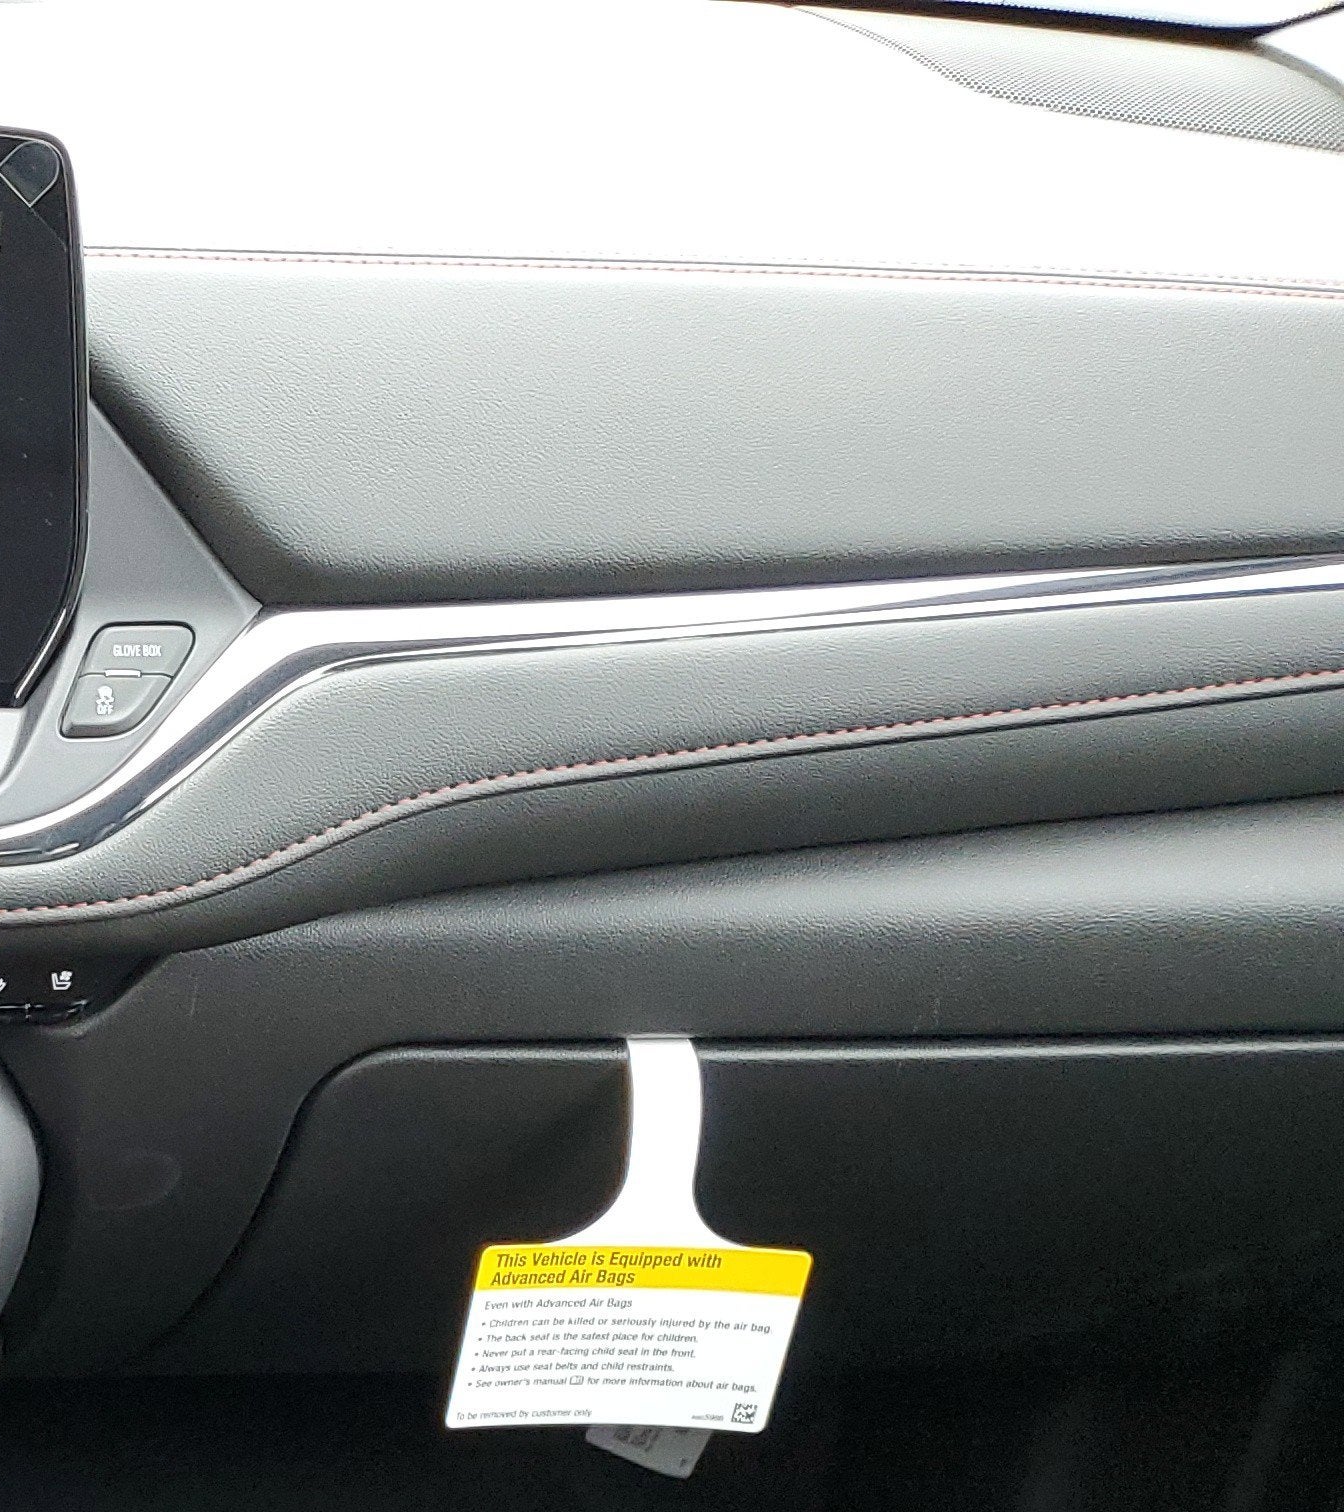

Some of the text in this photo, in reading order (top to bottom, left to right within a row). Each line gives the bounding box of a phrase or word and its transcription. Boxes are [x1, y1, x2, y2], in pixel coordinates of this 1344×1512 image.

[112, 644, 162, 657] GLOVE BOX
[496, 1251, 722, 1270] This Vehicle is Equipped with
[490, 1269, 635, 1287] Advanced Air Bags
[484, 1298, 633, 1311] Even with Advanced Air Bags
[489, 1318, 529, 1329] Children
[531, 1319, 550, 1327] can
[552, 1317, 565, 1327] be
[567, 1317, 595, 1327] killed
[611, 1317, 657, 1328] seriously
[659, 1318, 695, 1329] injured
[698, 1319, 711, 1330] by
[714, 1320, 730, 1331] the
[733, 1321, 748, 1332] air
[486, 1332, 699, 1344] The back seat is the safest place for children.
[482, 1349, 509, 1358] Never
[511, 1348, 527, 1359] put
[537, 1347, 589, 1358] rear-facing
[591, 1347, 615, 1357] child
[617, 1347, 638, 1357] seat
[640, 1347, 650, 1357] in
[652, 1347, 668, 1357] the
[478, 1361, 675, 1374] Always use seat belts and child restraints.
[475, 1378, 492, 1388] See
[532, 1376, 568, 1387] manual
[587, 1376, 601, 1385] for
[602, 1377, 626, 1386] more
[629, 1377, 683, 1388] information
[685, 1379, 714, 1390] about
[715, 1381, 730, 1391] air
[731, 1382, 757, 1394] bags.
[531, 1408, 571, 1418] customer
